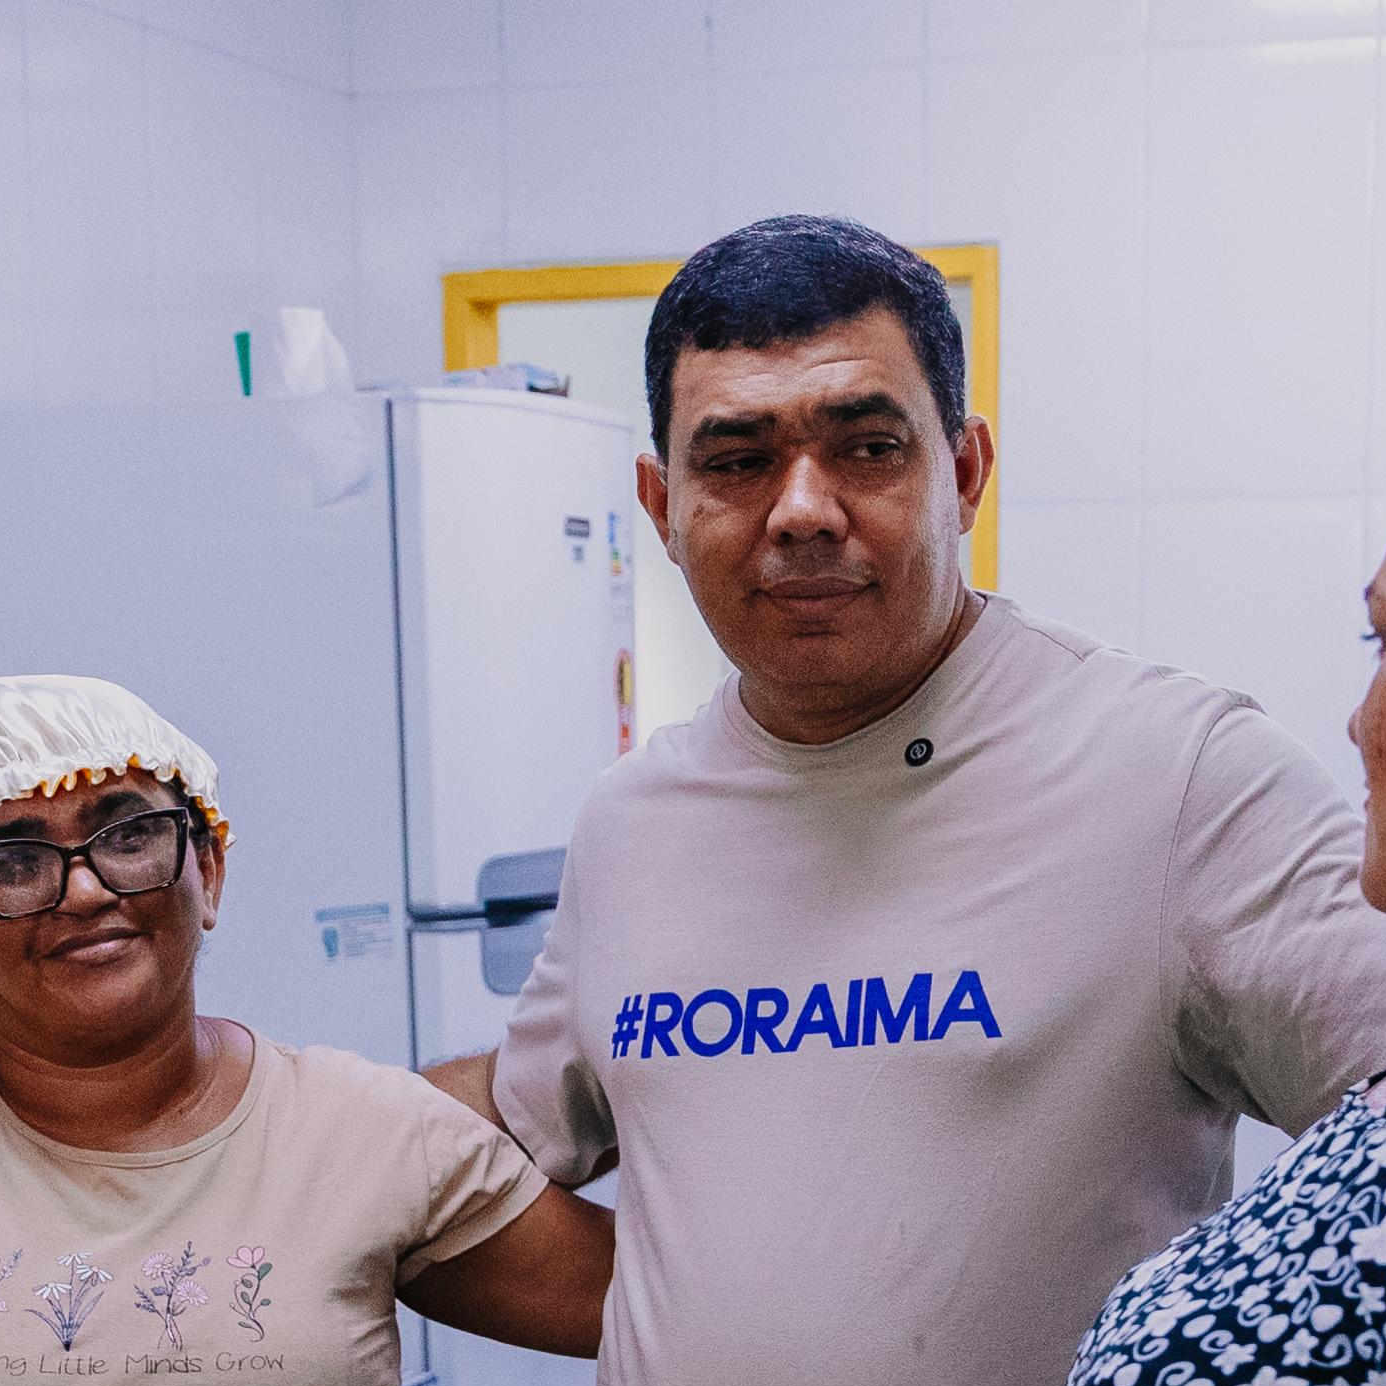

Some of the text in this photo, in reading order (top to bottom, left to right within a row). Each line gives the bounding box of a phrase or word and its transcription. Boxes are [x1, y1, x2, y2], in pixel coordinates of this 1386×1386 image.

[611, 970, 1003, 1059] #RORAIMA
[39, 1354, 109, 1376] Little
[125, 1356, 203, 1374] Minds
[215, 1352, 286, 1373] Grow
